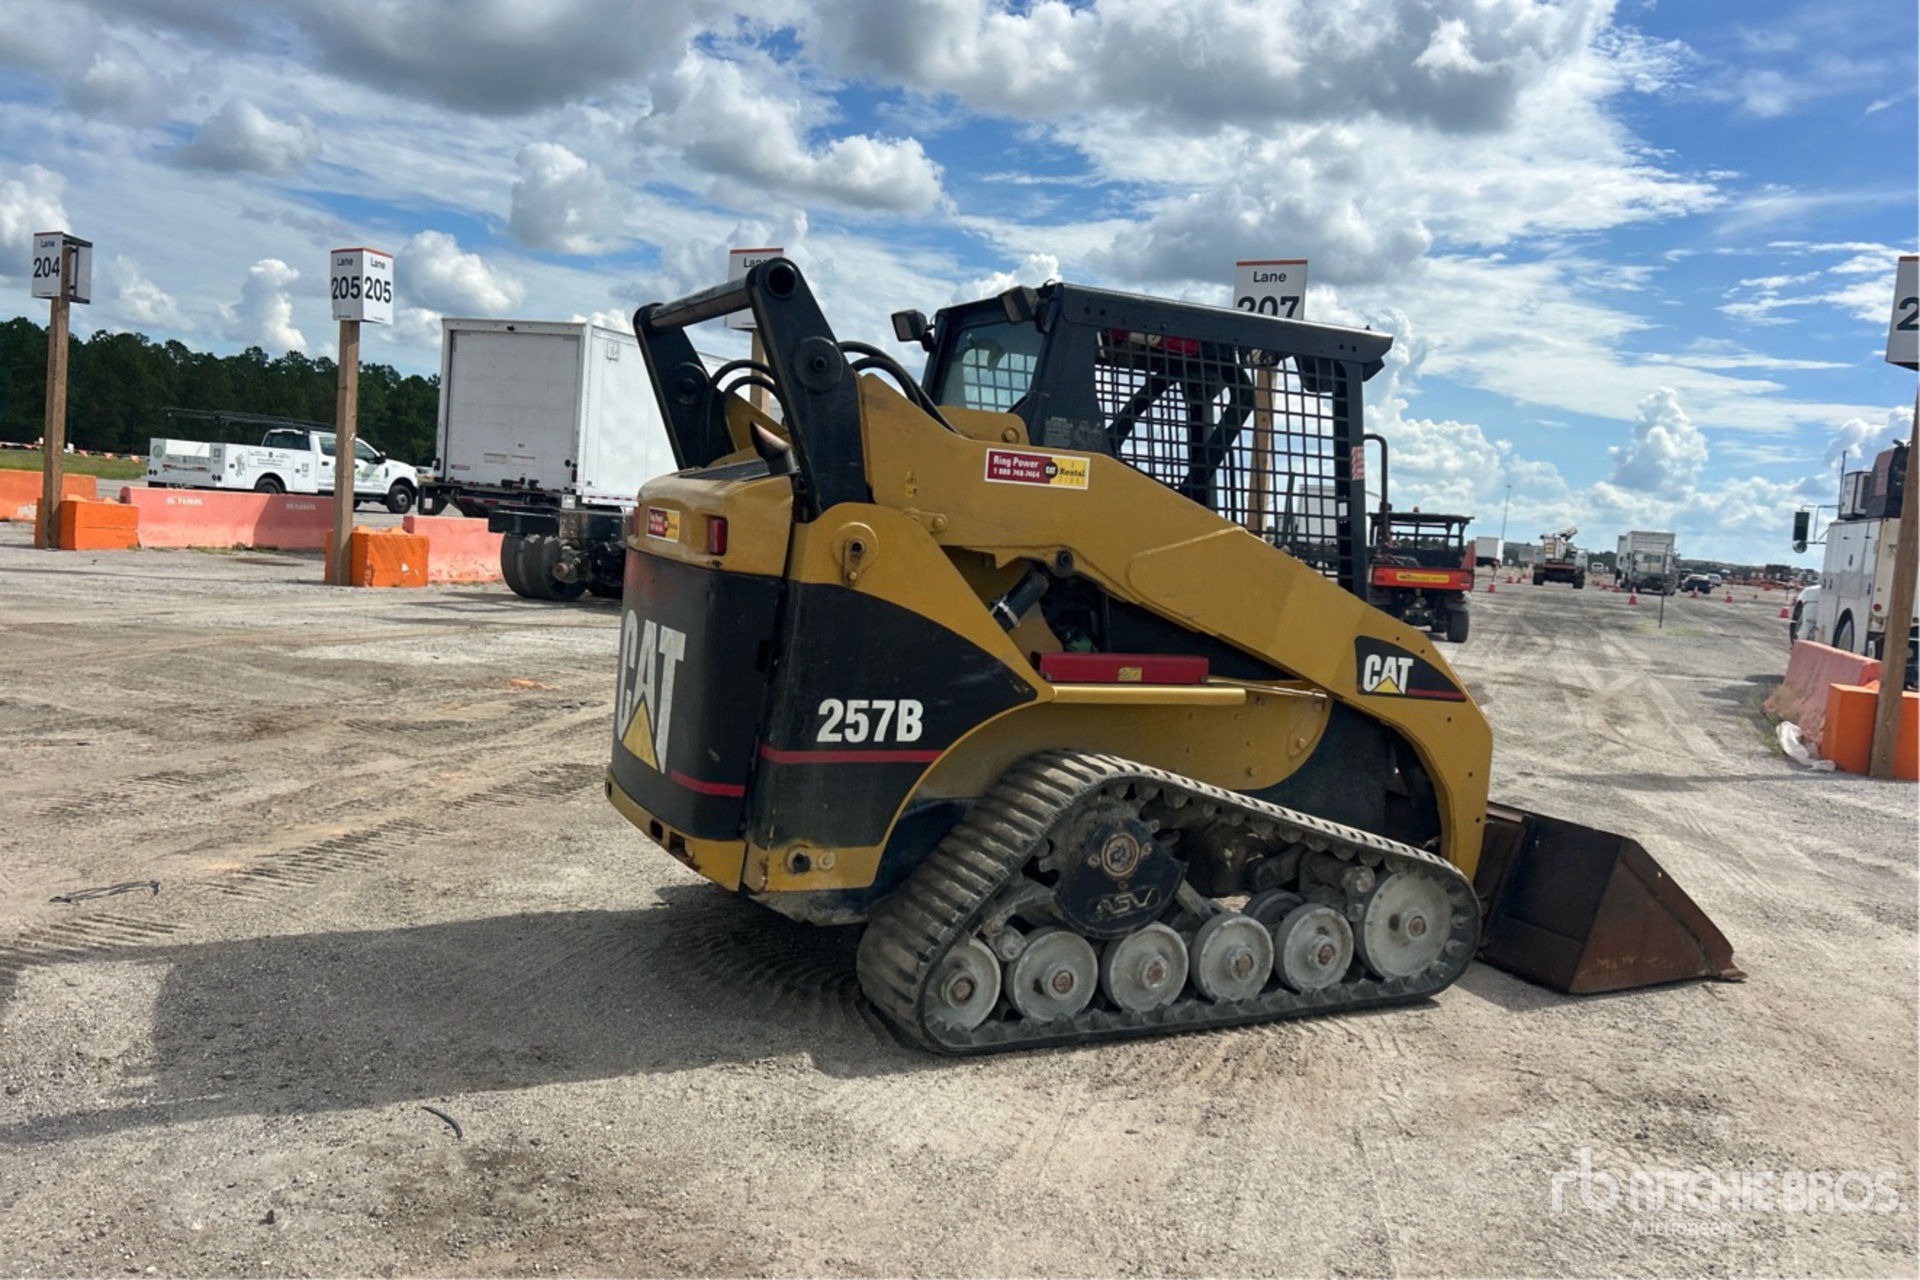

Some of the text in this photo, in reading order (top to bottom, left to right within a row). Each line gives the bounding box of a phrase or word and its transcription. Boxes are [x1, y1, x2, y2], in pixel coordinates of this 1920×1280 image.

[41, 240, 55, 248] Lane
[33, 256, 60, 278] 204
[337, 258, 353, 266] Lane
[371, 257, 385, 269] Lane
[331, 276, 361, 300] 205
[1253, 271, 1287, 283] Lane
[364, 275, 392, 304] 205
[993, 455, 1039, 469] Ring Power
[1362, 654, 1414, 694] CAT
[617, 609, 687, 775] CAT
[816, 698, 923, 743] 257B
